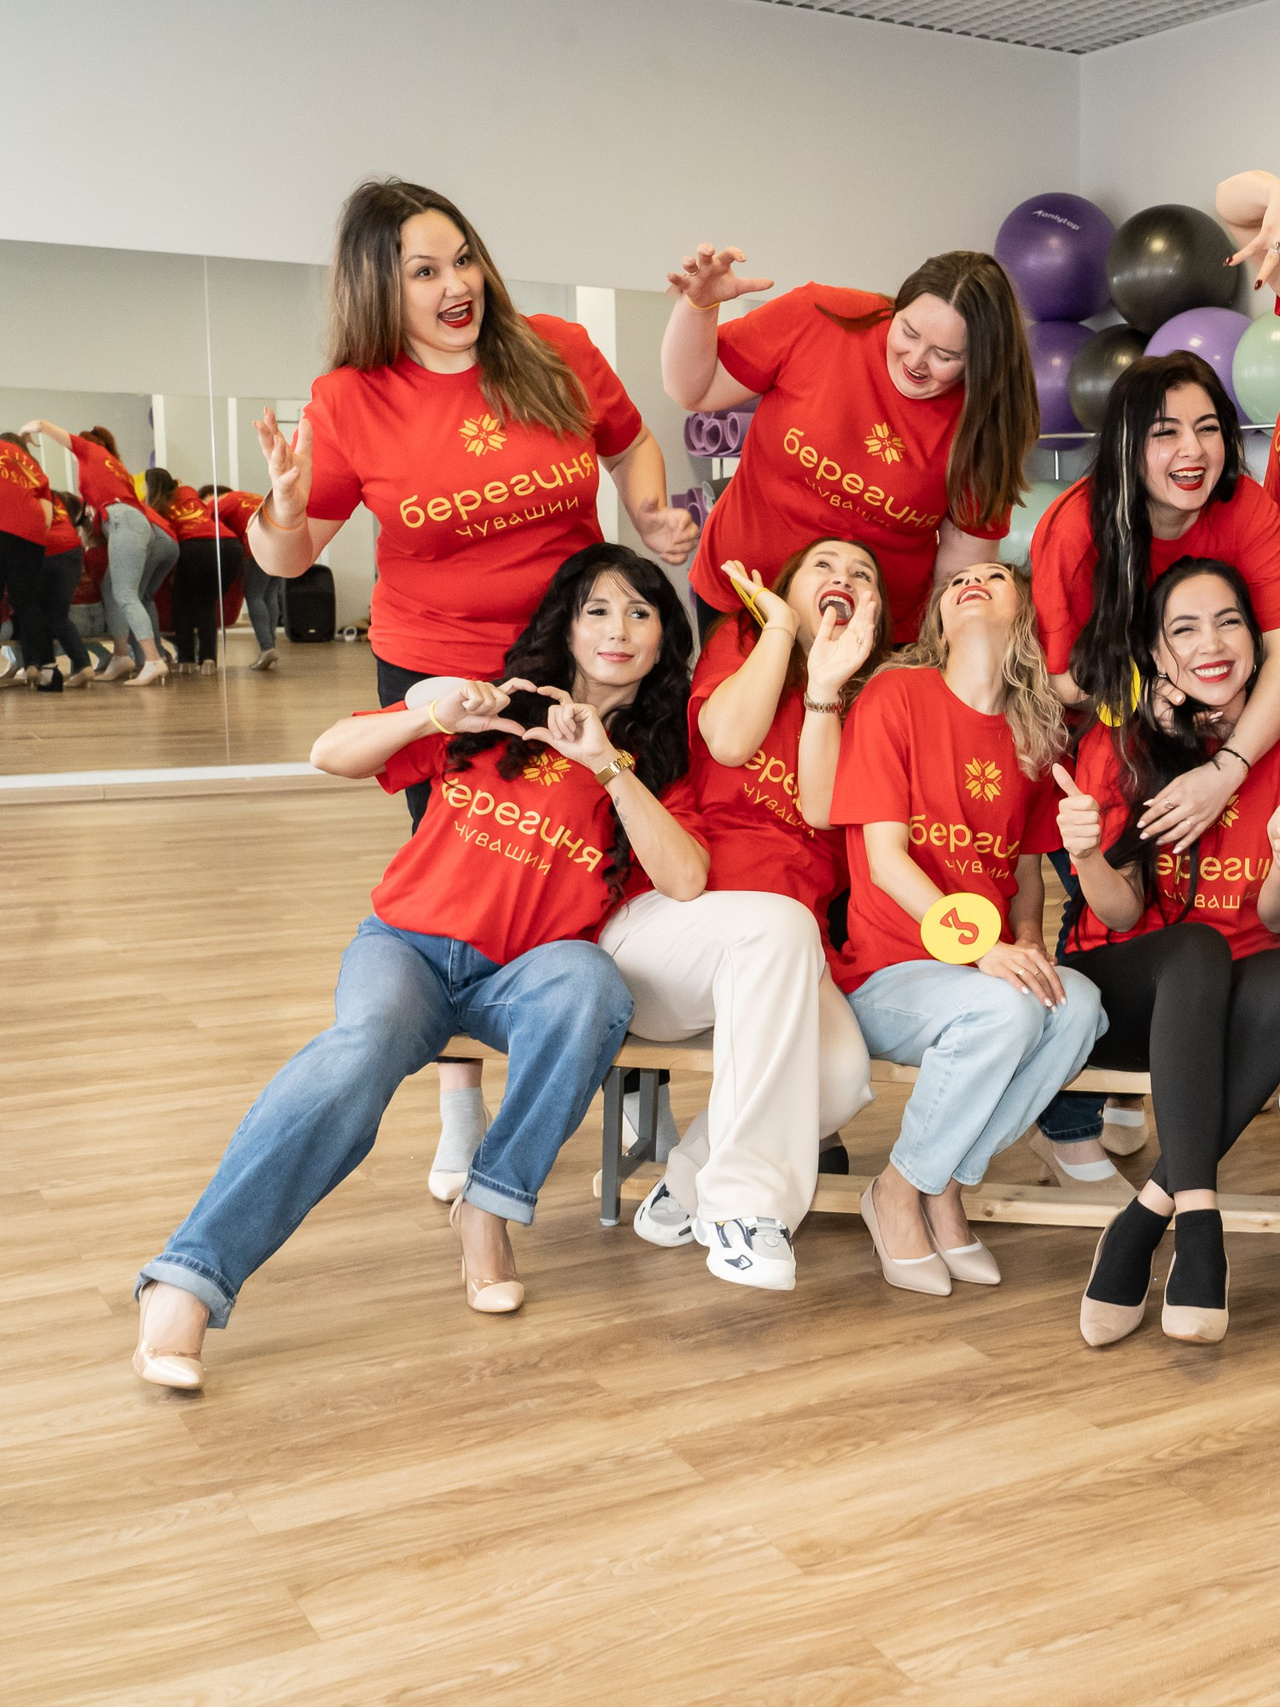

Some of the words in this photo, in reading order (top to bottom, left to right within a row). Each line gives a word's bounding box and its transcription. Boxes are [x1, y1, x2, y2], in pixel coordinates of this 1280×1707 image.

[1041, 211, 1080, 231] onlytop
[399, 452, 597, 529] берегиня
[784, 427, 940, 528] берегиня
[455, 496, 580, 539] чувашии
[453, 820, 552, 876] чувашии
